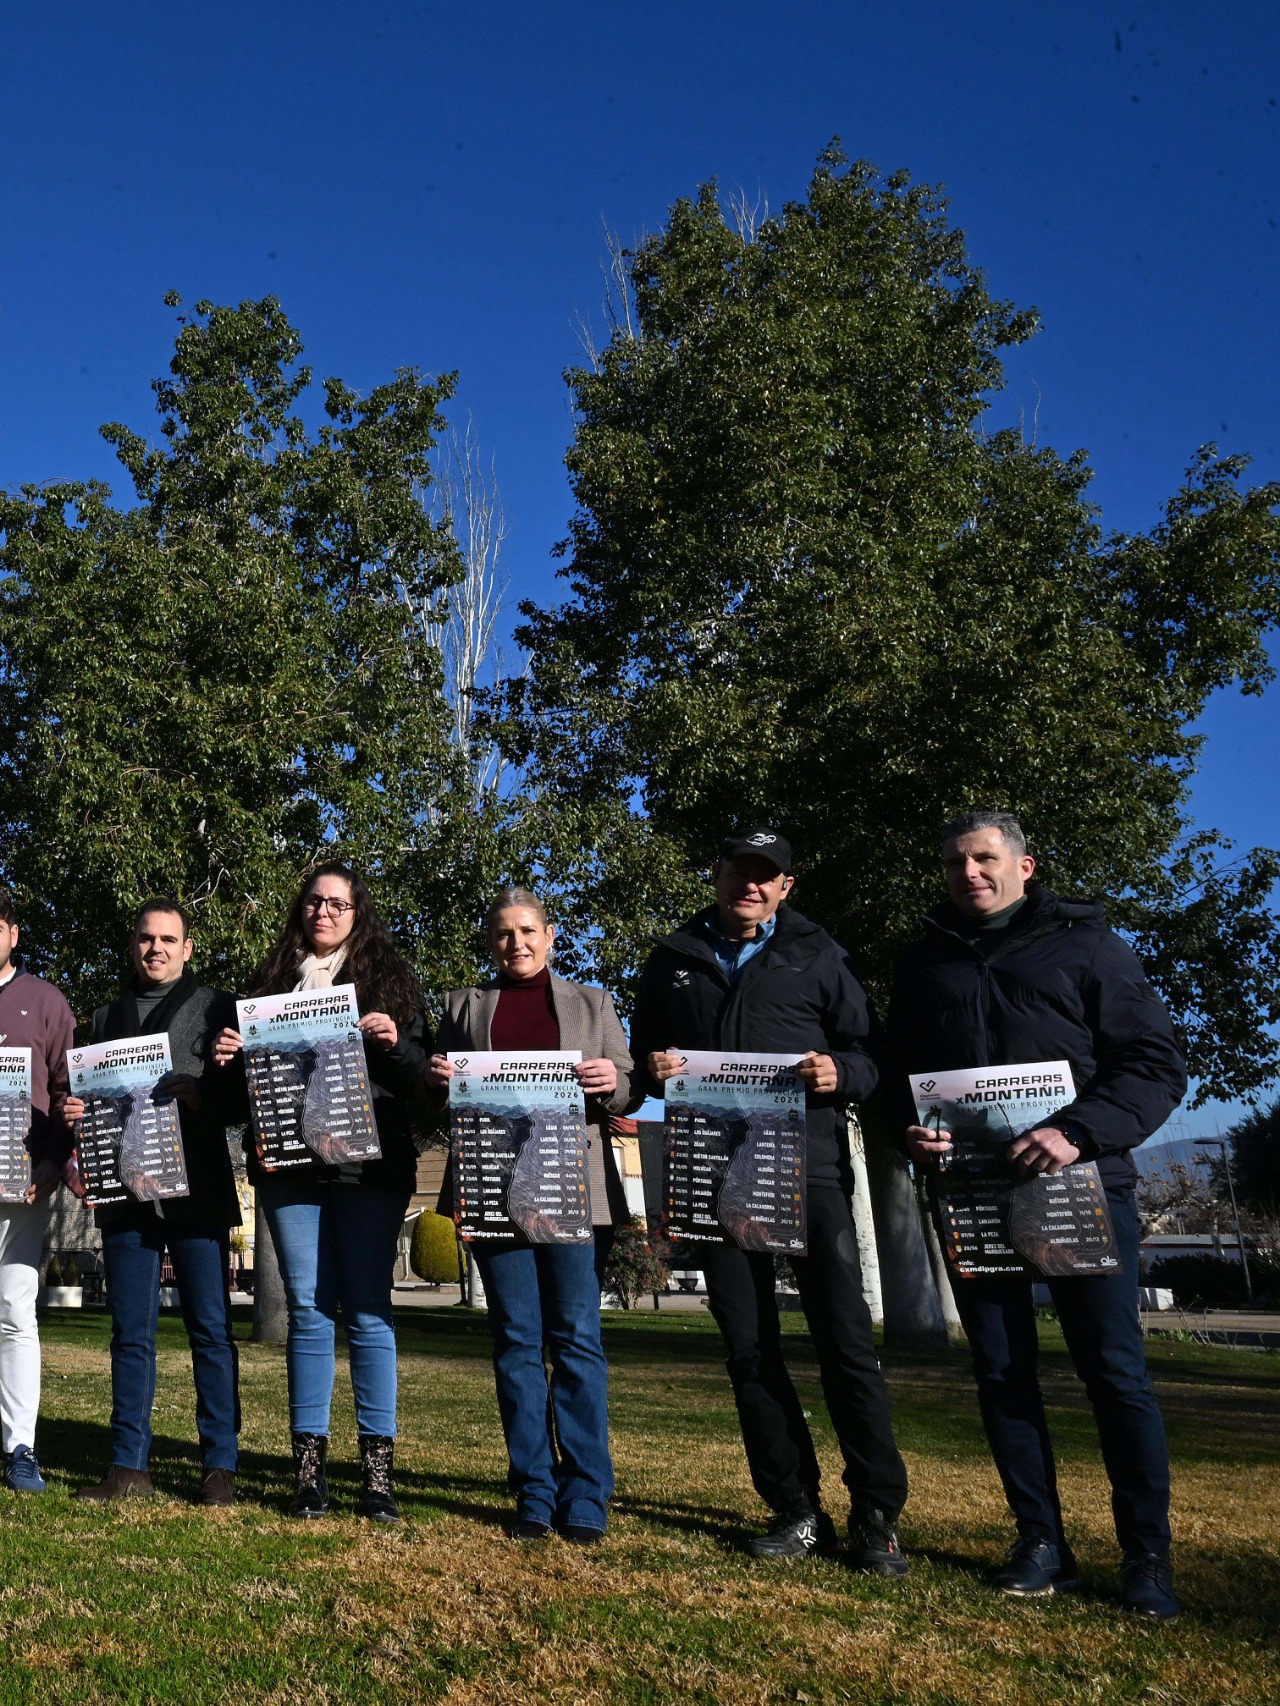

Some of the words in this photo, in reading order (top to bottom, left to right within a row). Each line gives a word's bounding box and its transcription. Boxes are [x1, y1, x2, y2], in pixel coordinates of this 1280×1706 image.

[284, 994, 349, 1011] CARRERAS
[105, 1043, 163, 1058] CARRERAS
[500, 1062, 574, 1070] CARRERAS
[719, 1062, 796, 1074] CARRERAS
[975, 1073, 1062, 1089] CARRERAS
[721, 1086, 750, 1094] PREMIO
[774, 1096, 799, 1104] 2026
